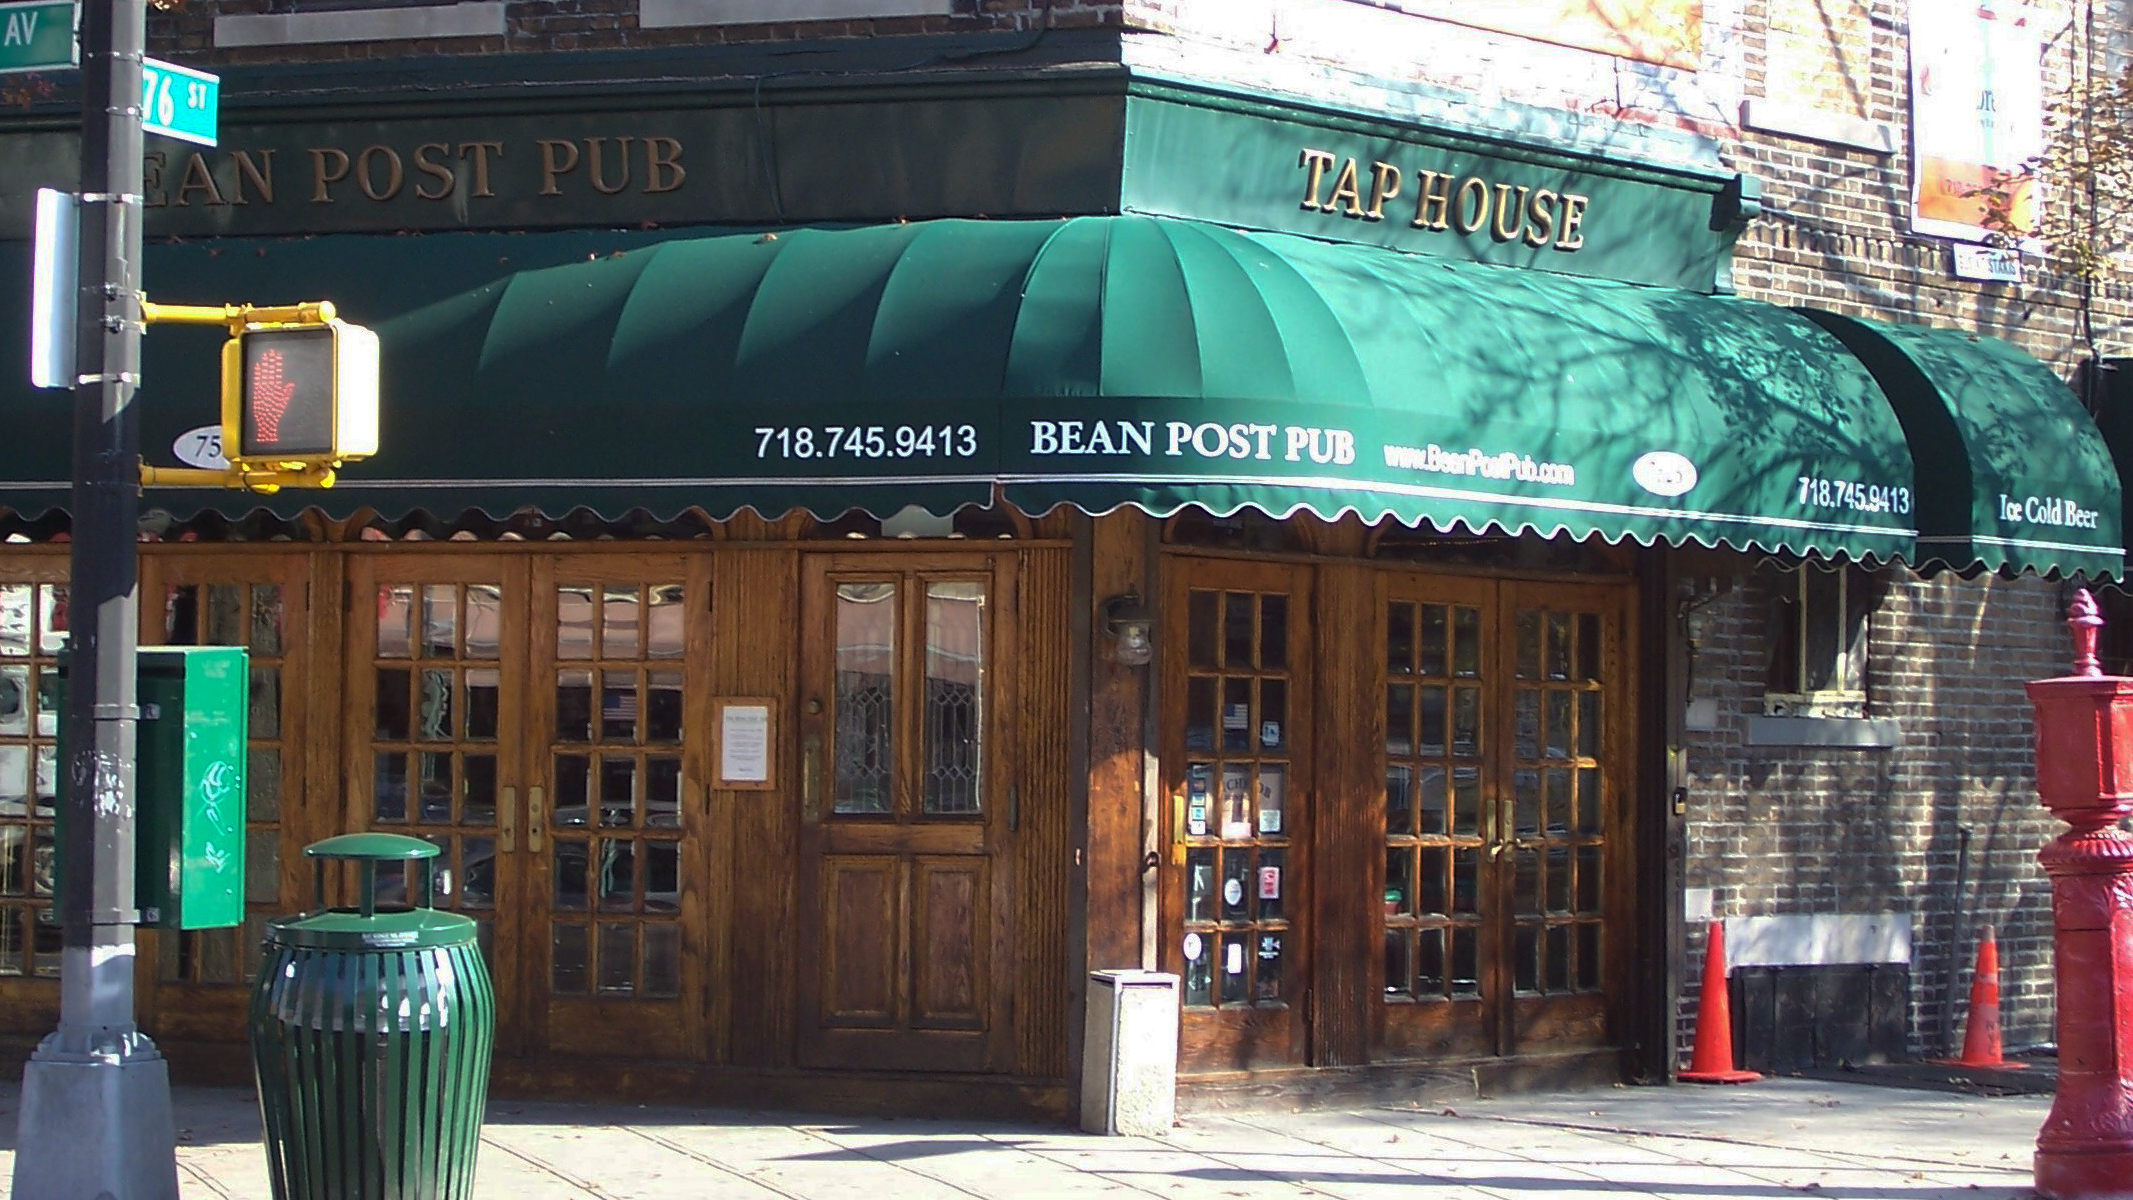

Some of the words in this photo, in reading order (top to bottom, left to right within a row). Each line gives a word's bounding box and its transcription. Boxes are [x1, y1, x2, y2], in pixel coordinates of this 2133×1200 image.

[4, 11, 38, 47] AV
[143, 69, 175, 127] 76
[143, 149, 276, 208] EAN
[307, 141, 503, 203] POST
[537, 136, 687, 196] PUB
[1298, 148, 1401, 222] TAP
[1410, 169, 1589, 251] HOUSE
[196, 435, 221, 458] 75
[754, 425, 978, 459] 718.745.9413
[1031, 420, 1154, 456] BEAN
[1165, 421, 1276, 461] POST
[1285, 427, 1357, 465] PUB
[1799, 477, 1909, 514] 718.745.9413
[2000, 494, 2022, 522] Ice
[2025, 496, 2061, 525] Cold
[2064, 499, 2098, 529] Beer
